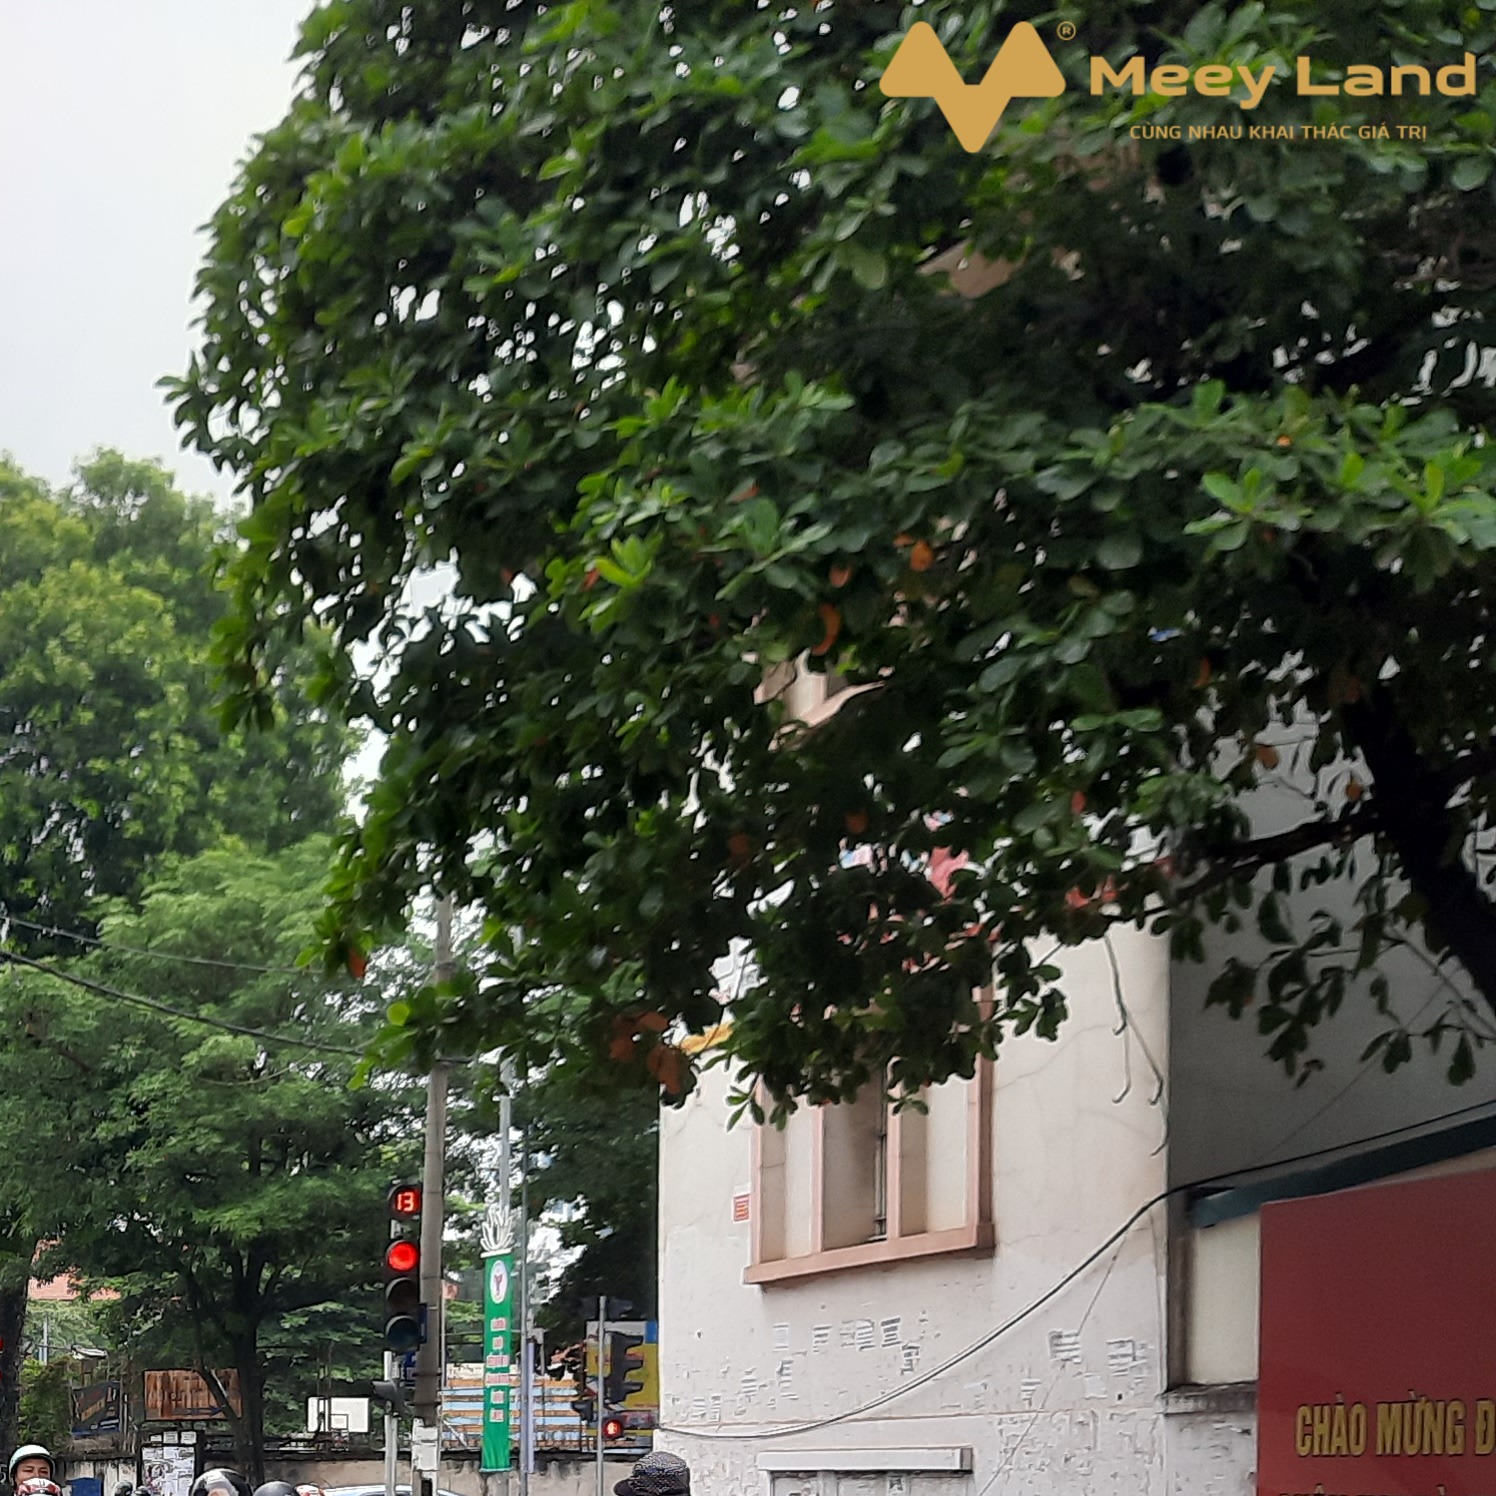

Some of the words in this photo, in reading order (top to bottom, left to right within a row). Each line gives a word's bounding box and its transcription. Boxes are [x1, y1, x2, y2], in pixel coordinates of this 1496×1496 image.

[397, 1192, 414, 1212] 13
[1296, 1391, 1368, 1457] CHÀO
[1375, 1389, 1466, 1457] MỪNG
